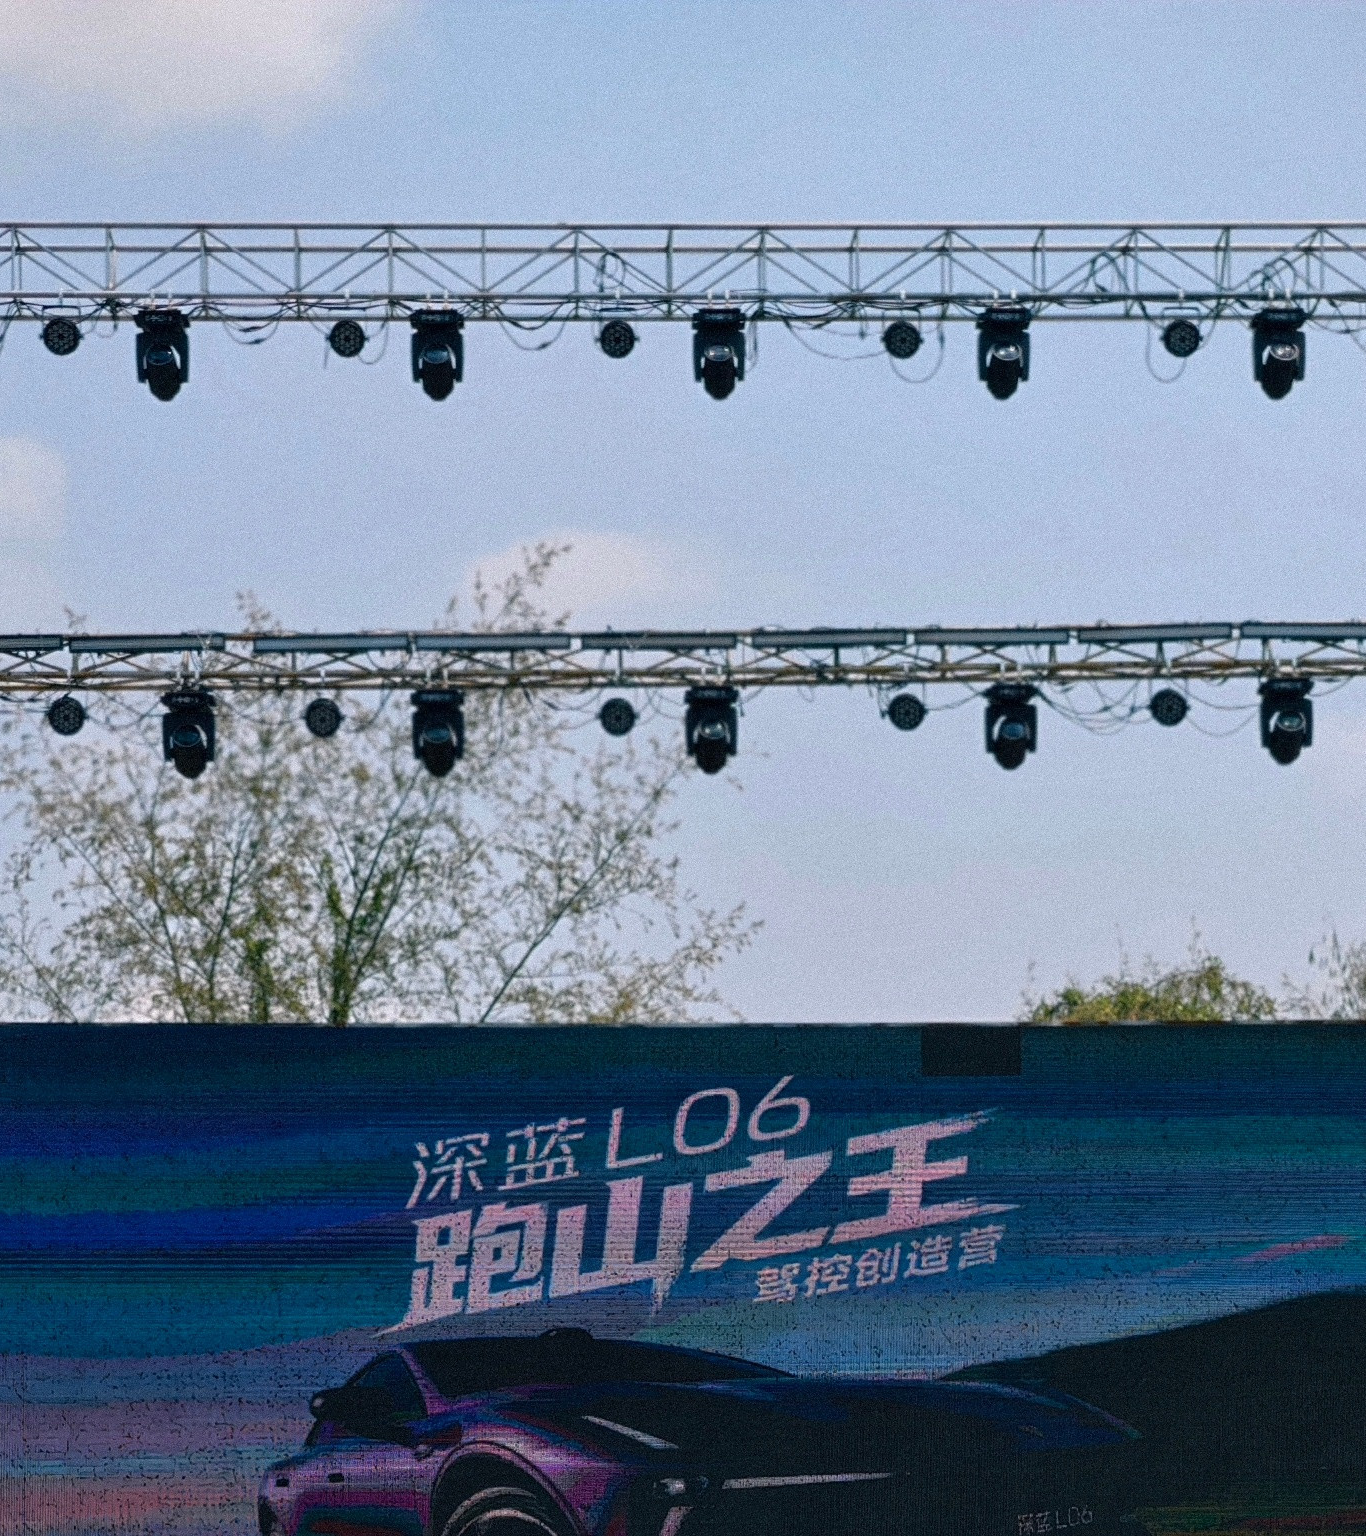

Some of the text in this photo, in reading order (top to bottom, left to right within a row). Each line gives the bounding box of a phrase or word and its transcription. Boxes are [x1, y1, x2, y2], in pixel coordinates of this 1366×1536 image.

[406, 1075, 811, 1209] 深蓝L06
[373, 1108, 1021, 1336] 跑山之王
[753, 1225, 1006, 1303] 驾控创造营
